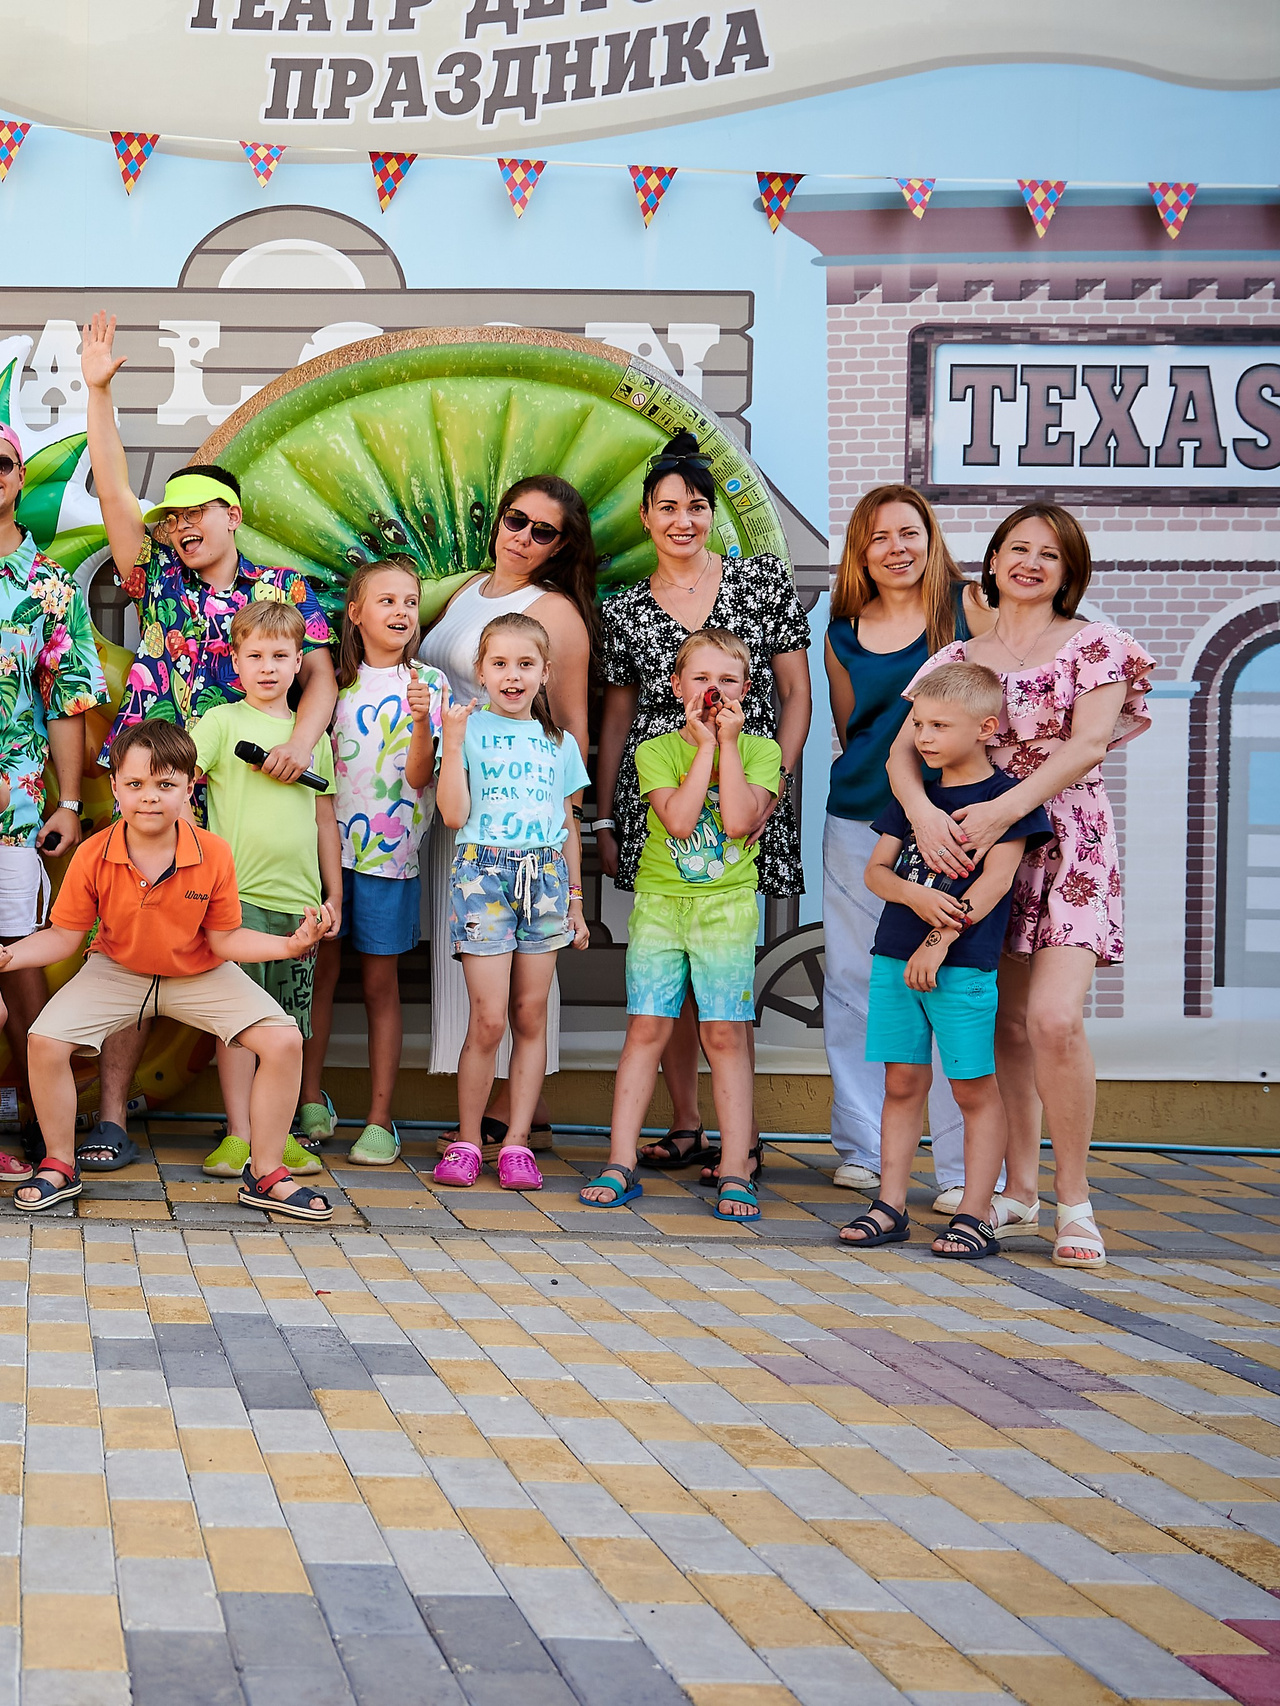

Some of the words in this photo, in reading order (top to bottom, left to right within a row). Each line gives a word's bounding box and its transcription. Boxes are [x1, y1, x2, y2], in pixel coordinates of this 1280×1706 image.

[263, 9, 770, 126] ПРАЗДНИКА
[950, 363, 1280, 471] TEXAS
[481, 735, 516, 750] LET
[528, 736, 557, 758] THE
[480, 761, 555, 787] WORLD
[481, 786, 520, 801] HEAR
[665, 822, 718, 860] SODA
[184, 890, 209, 902] Warp
